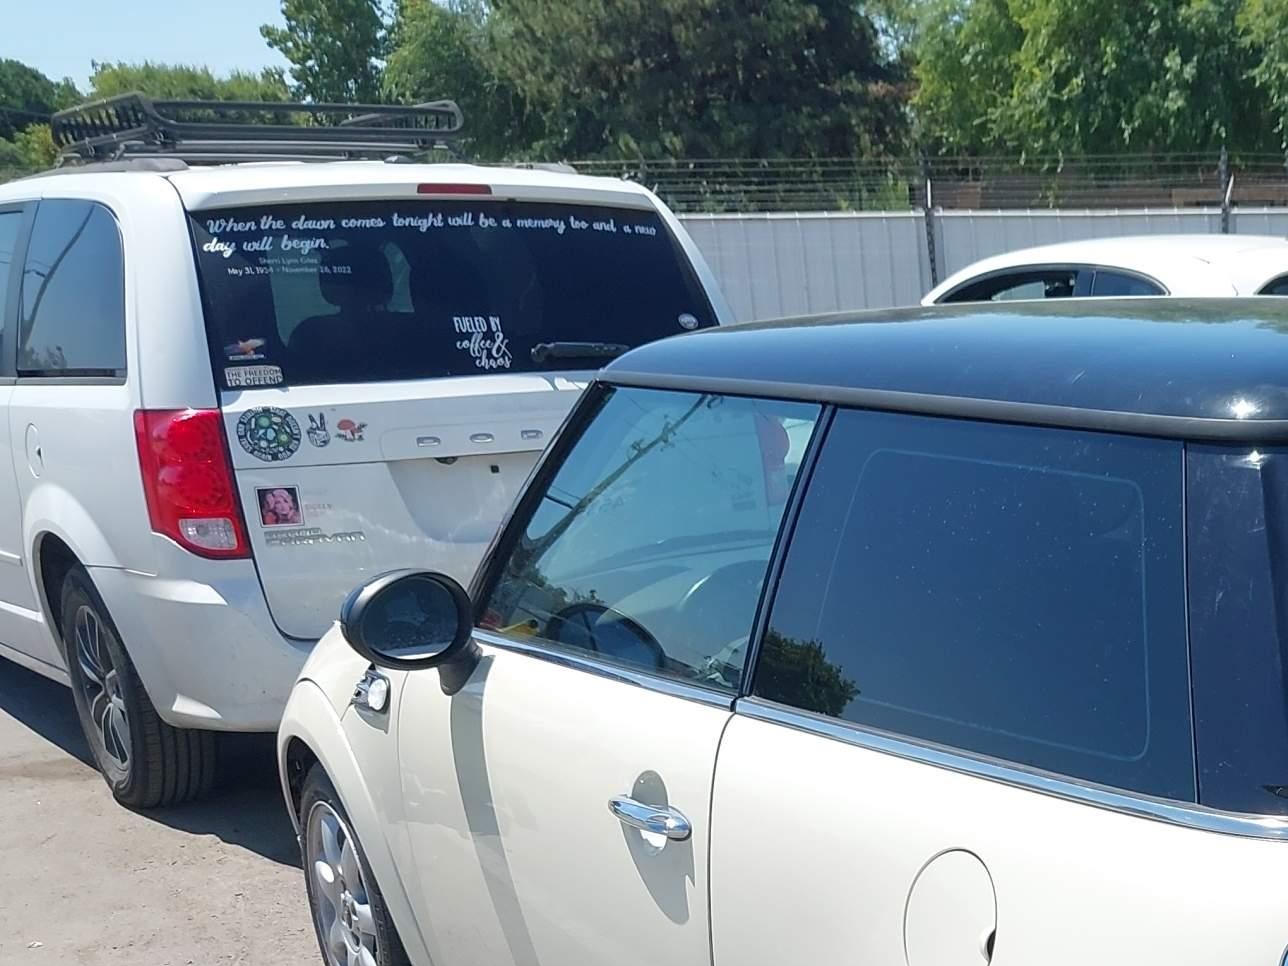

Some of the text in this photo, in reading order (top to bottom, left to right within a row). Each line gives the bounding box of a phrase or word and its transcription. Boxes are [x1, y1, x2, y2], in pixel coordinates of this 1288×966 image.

[206, 212, 656, 236] When the dawn comes tonight will be a memory too and a new
[202, 234, 331, 258] day will begin.
[227, 267, 243, 277] May
[453, 316, 502, 334] FUELED BY
[456, 333, 513, 359] coffee &
[475, 352, 512, 369] chaos
[228, 378, 241, 386] TO
[416, 429, 544, 448] DOD
